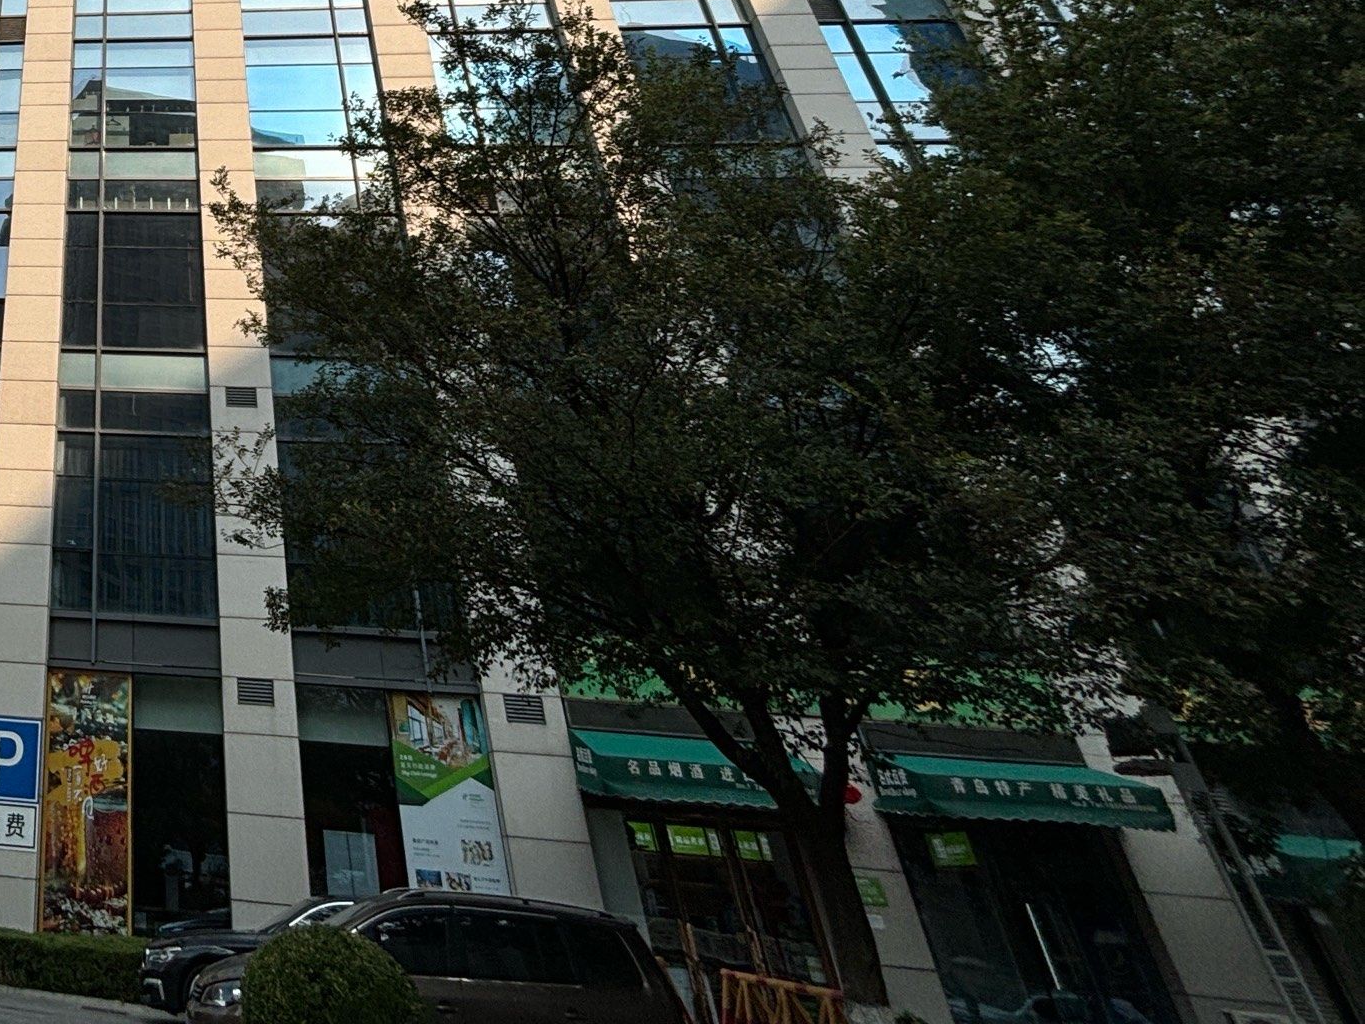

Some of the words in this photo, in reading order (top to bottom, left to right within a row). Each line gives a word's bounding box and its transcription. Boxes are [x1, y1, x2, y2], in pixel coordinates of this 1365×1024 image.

[627, 759, 704, 779] 名品烟酒
[949, 776, 1032, 796] 青岛特产
